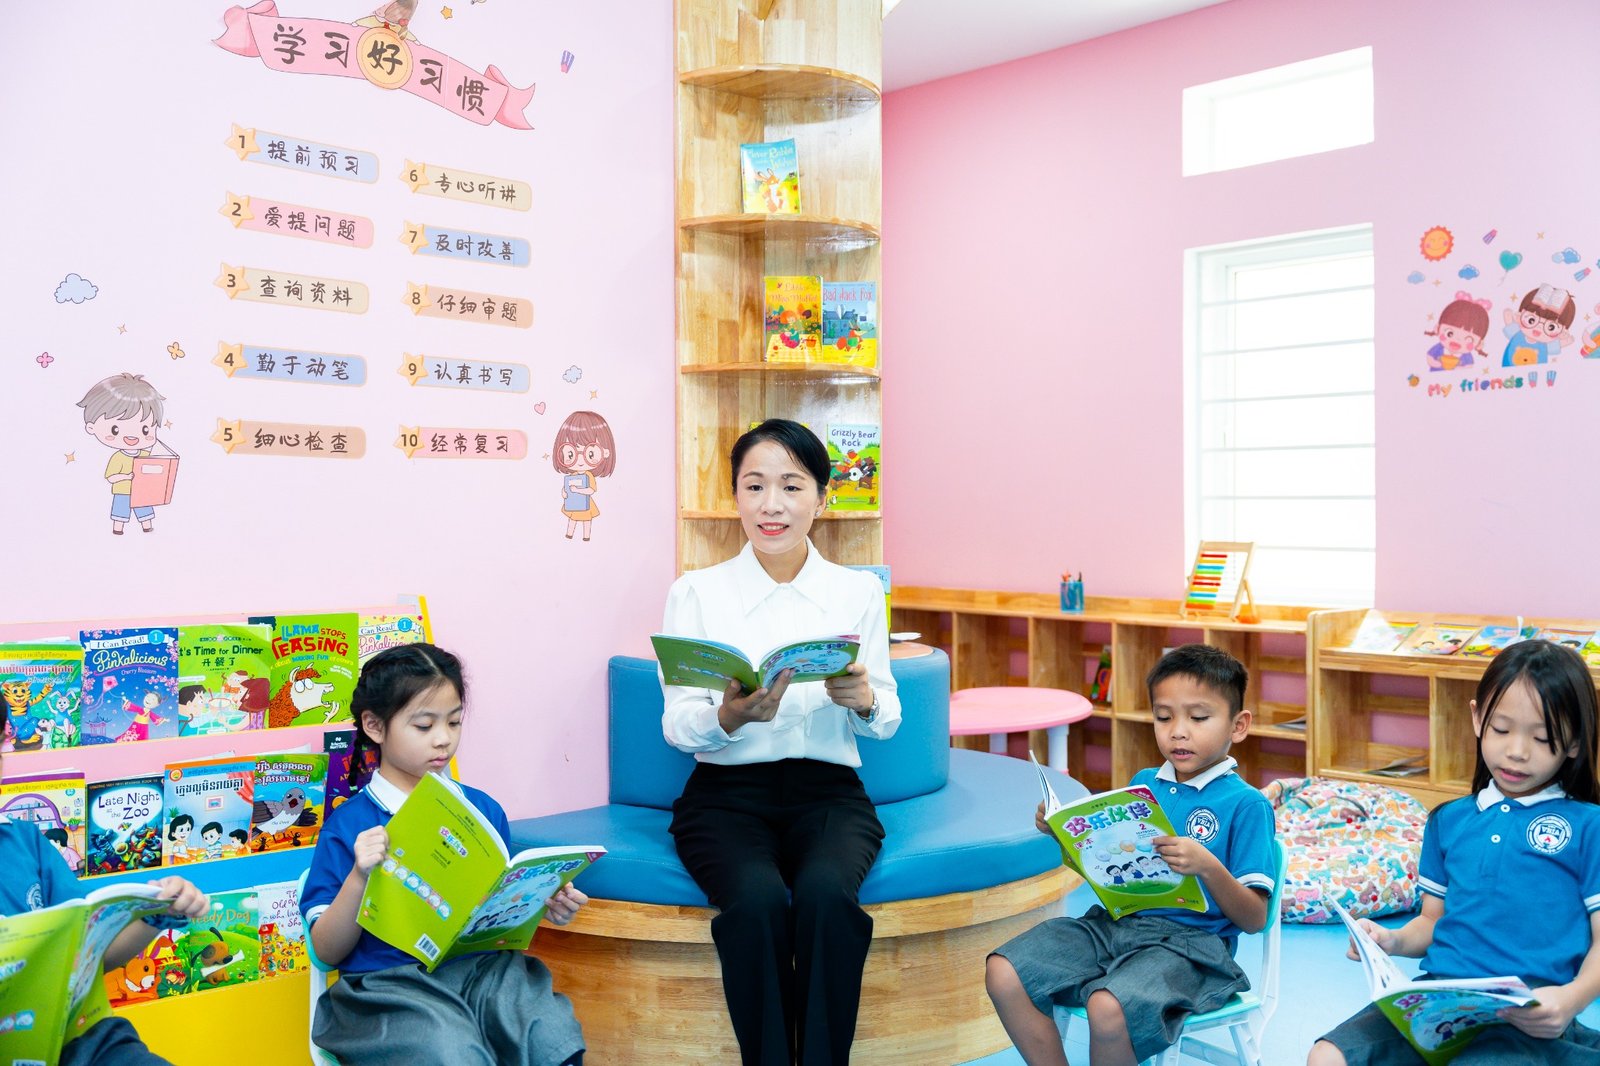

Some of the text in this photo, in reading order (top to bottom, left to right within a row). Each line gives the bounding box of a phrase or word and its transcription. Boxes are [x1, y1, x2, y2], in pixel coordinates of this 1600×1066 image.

[272, 23, 490, 117] 学习好习惯
[238, 134, 360, 175] 1 提前预习
[409, 169, 517, 204] 6 专心听讲
[231, 202, 357, 242] 2 爱提问题
[408, 230, 514, 261] 7 及时改善
[226, 273, 353, 307] 3 查询资料
[411, 292, 518, 322] 8 仔细审题
[223, 352, 349, 381] 4 勤于动笔
[407, 361, 513, 386] 9 认真书写
[1427, 376, 1524, 398] My friends
[223, 427, 349, 454] 5 细心检查
[400, 432, 510, 454] 10 经常复习
[831, 428, 877, 439] Grizzly Bear
[841, 437, 862, 447] Rock
[102, 640, 119, 648] Can
[121, 636, 145, 646] Read!
[153, 631, 159, 642] 1
[281, 624, 347, 642] LLAMA STOPS
[193, 646, 216, 656] Time
[232, 644, 264, 655] Dinner
[272, 637, 348, 661] TEASING
[92, 649, 169, 673] Pinkalicious
[98, 791, 160, 809] Late Night
[123, 806, 149, 820] Zoo
[1065, 802, 1152, 837] 欢乐伙伴
[1138, 823, 1147, 831] 2
[226, 908, 251, 924] Dog
[272, 899, 288, 910] Old
